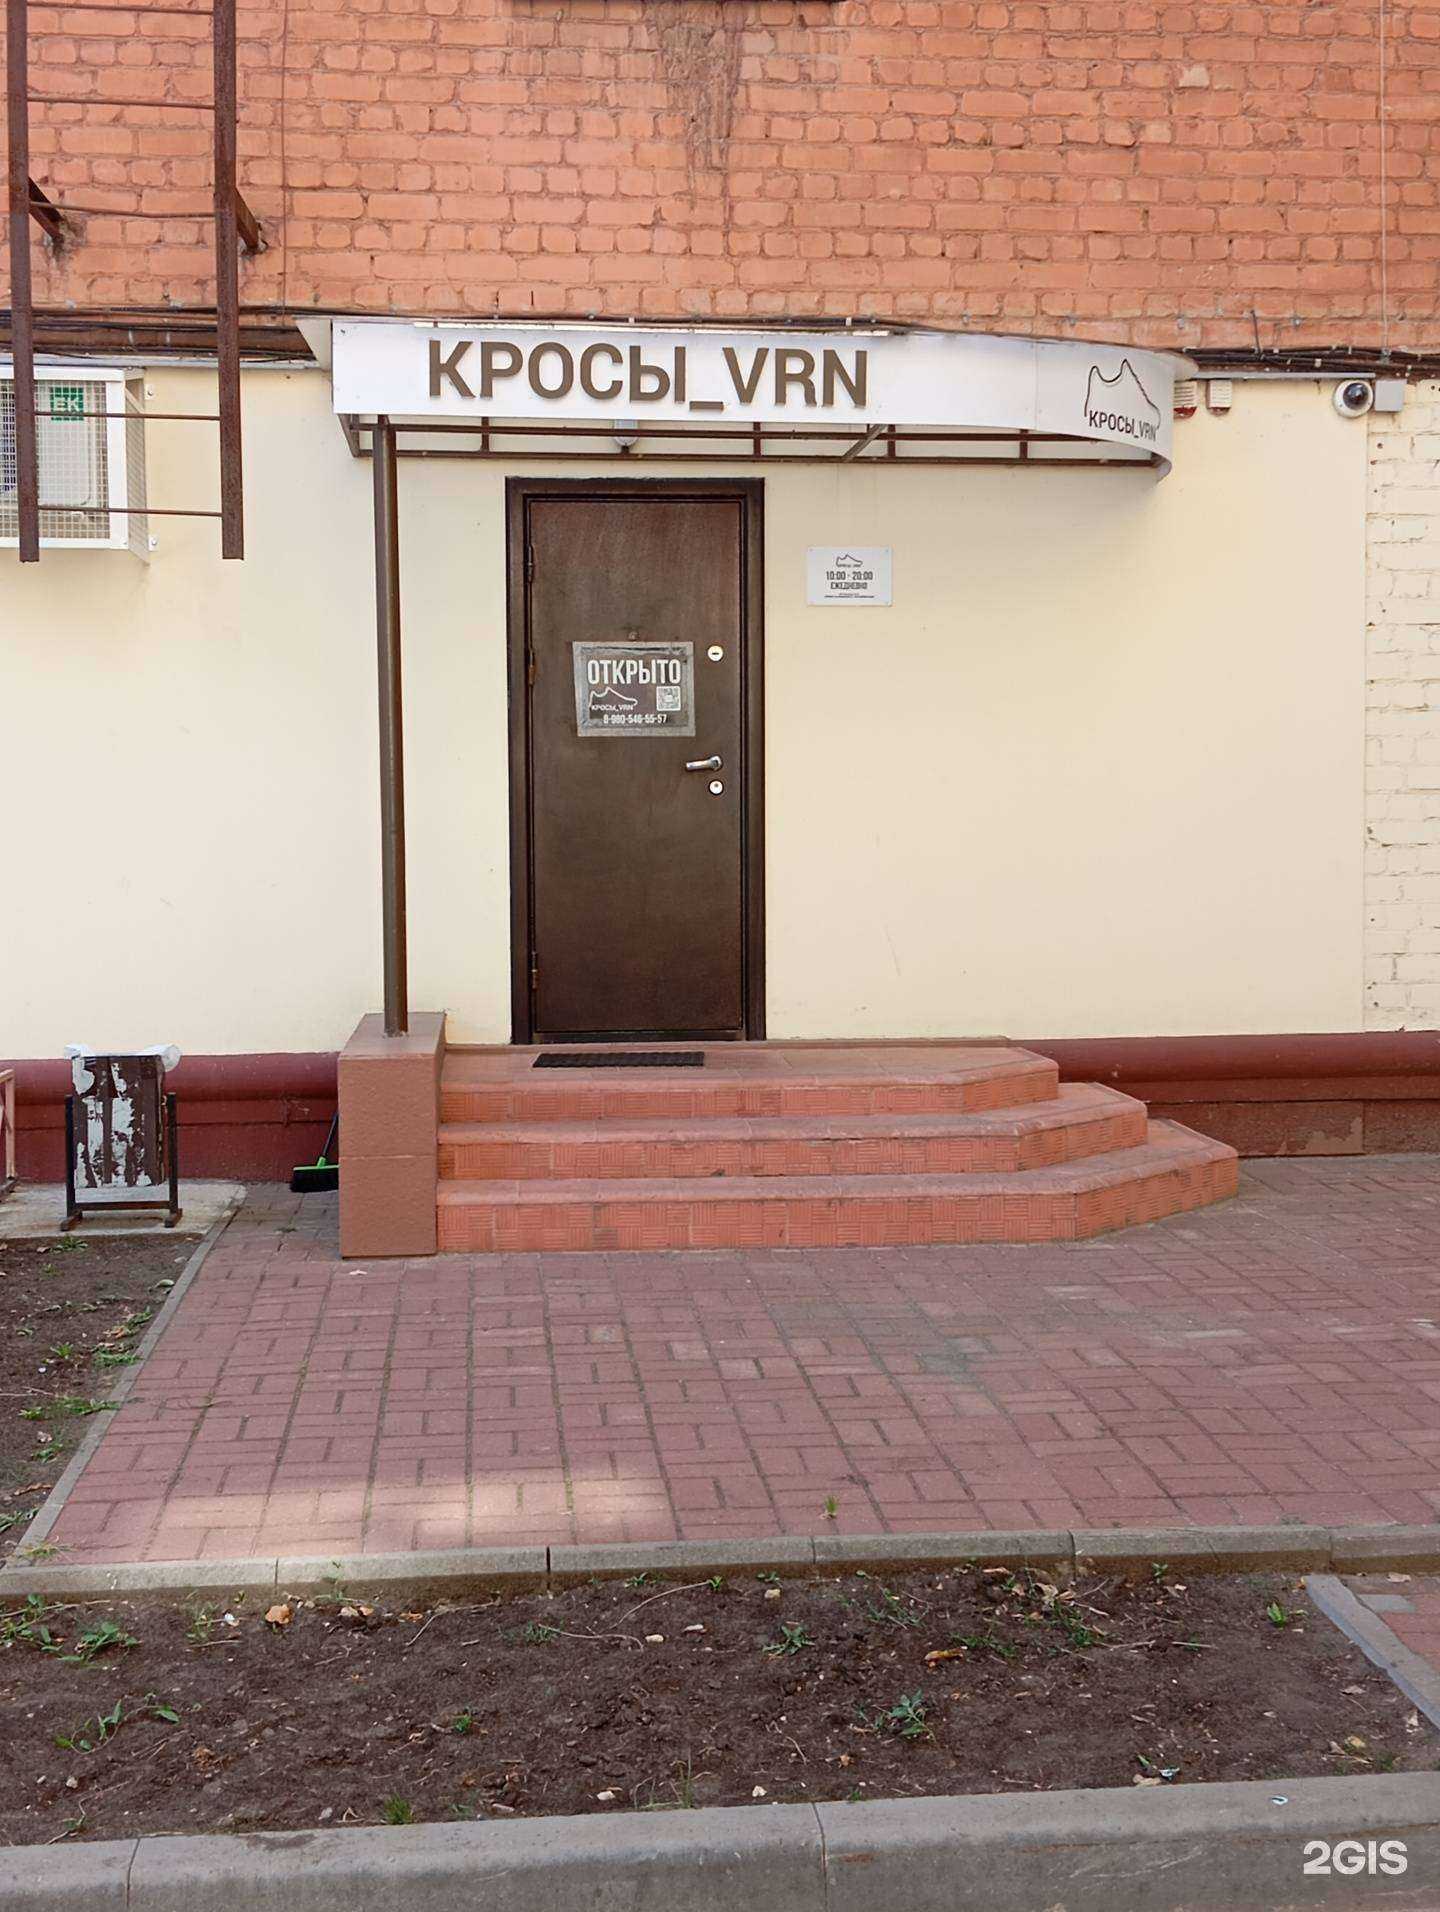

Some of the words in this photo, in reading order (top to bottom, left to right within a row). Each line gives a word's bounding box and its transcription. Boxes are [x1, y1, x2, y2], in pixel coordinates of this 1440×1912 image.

[429, 339, 868, 411] КРОСЫ_VRN
[1089, 410, 1158, 442] КРОСЫ_VRN
[587, 659, 681, 685] ОТКРЫТО
